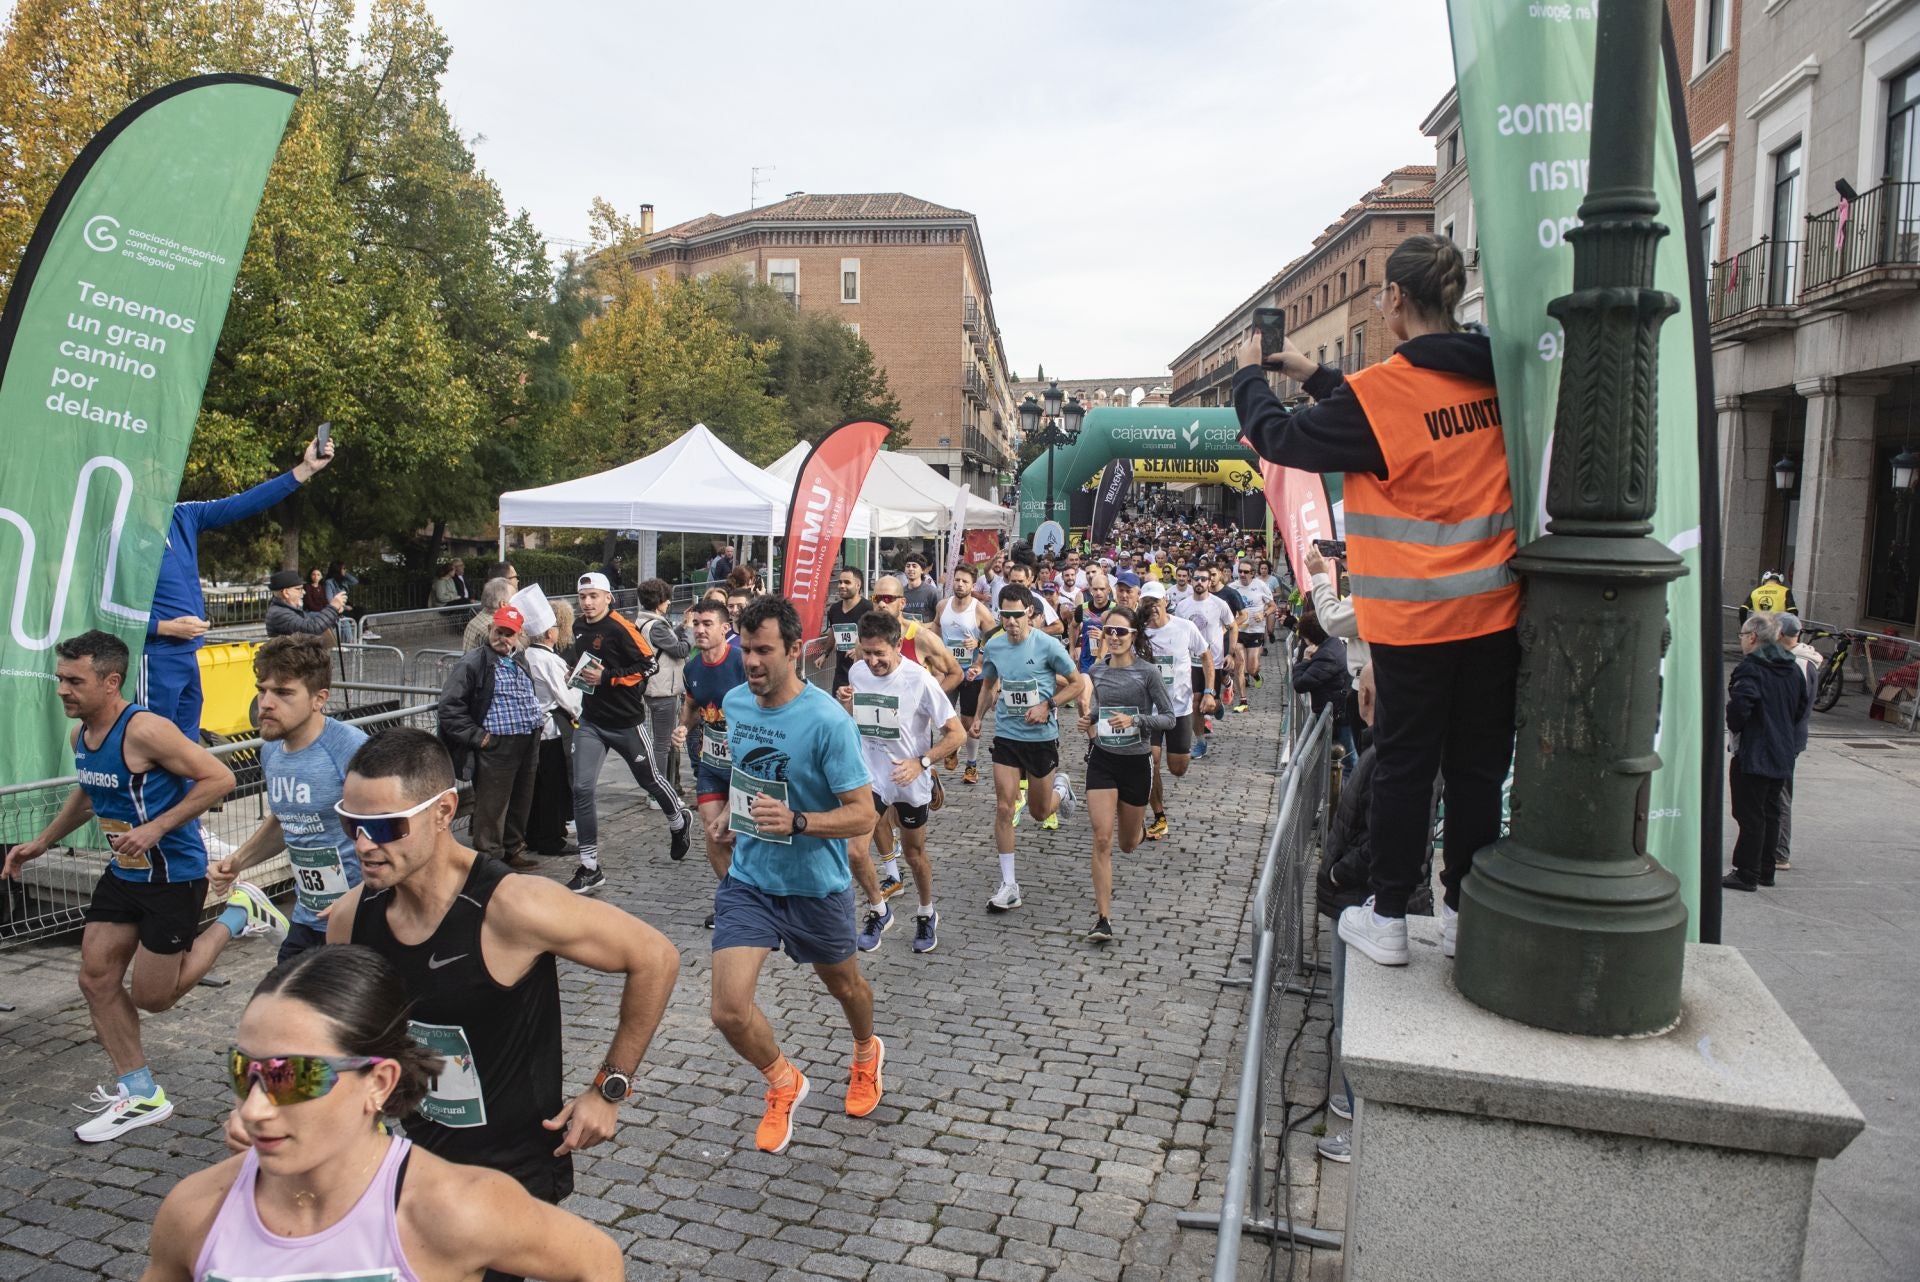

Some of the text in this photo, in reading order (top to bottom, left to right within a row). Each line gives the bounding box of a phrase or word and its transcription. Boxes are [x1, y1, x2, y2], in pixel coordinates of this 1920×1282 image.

[125, 238, 204, 268] contra el cáncer
[128, 227, 226, 265] asociación española
[121, 249, 176, 271] en Segovia
[77, 280, 195, 334] Tenemos
[67, 312, 166, 354] un gran
[59, 340, 156, 379] camino
[50, 366, 99, 392] por
[45, 392, 148, 434] delante
[1424, 397, 1502, 441] VOLUNT
[1111, 425, 1177, 443] cajaviva
[1022, 500, 1067, 512] cajarral
[841, 632, 852, 643] 149
[952, 647, 965, 657] 198
[1010, 692, 1028, 705] 194
[875, 708, 880, 724] 1
[711, 742, 727, 758] 134
[272, 776, 311, 804] UVa
[298, 869, 325, 892] 153
